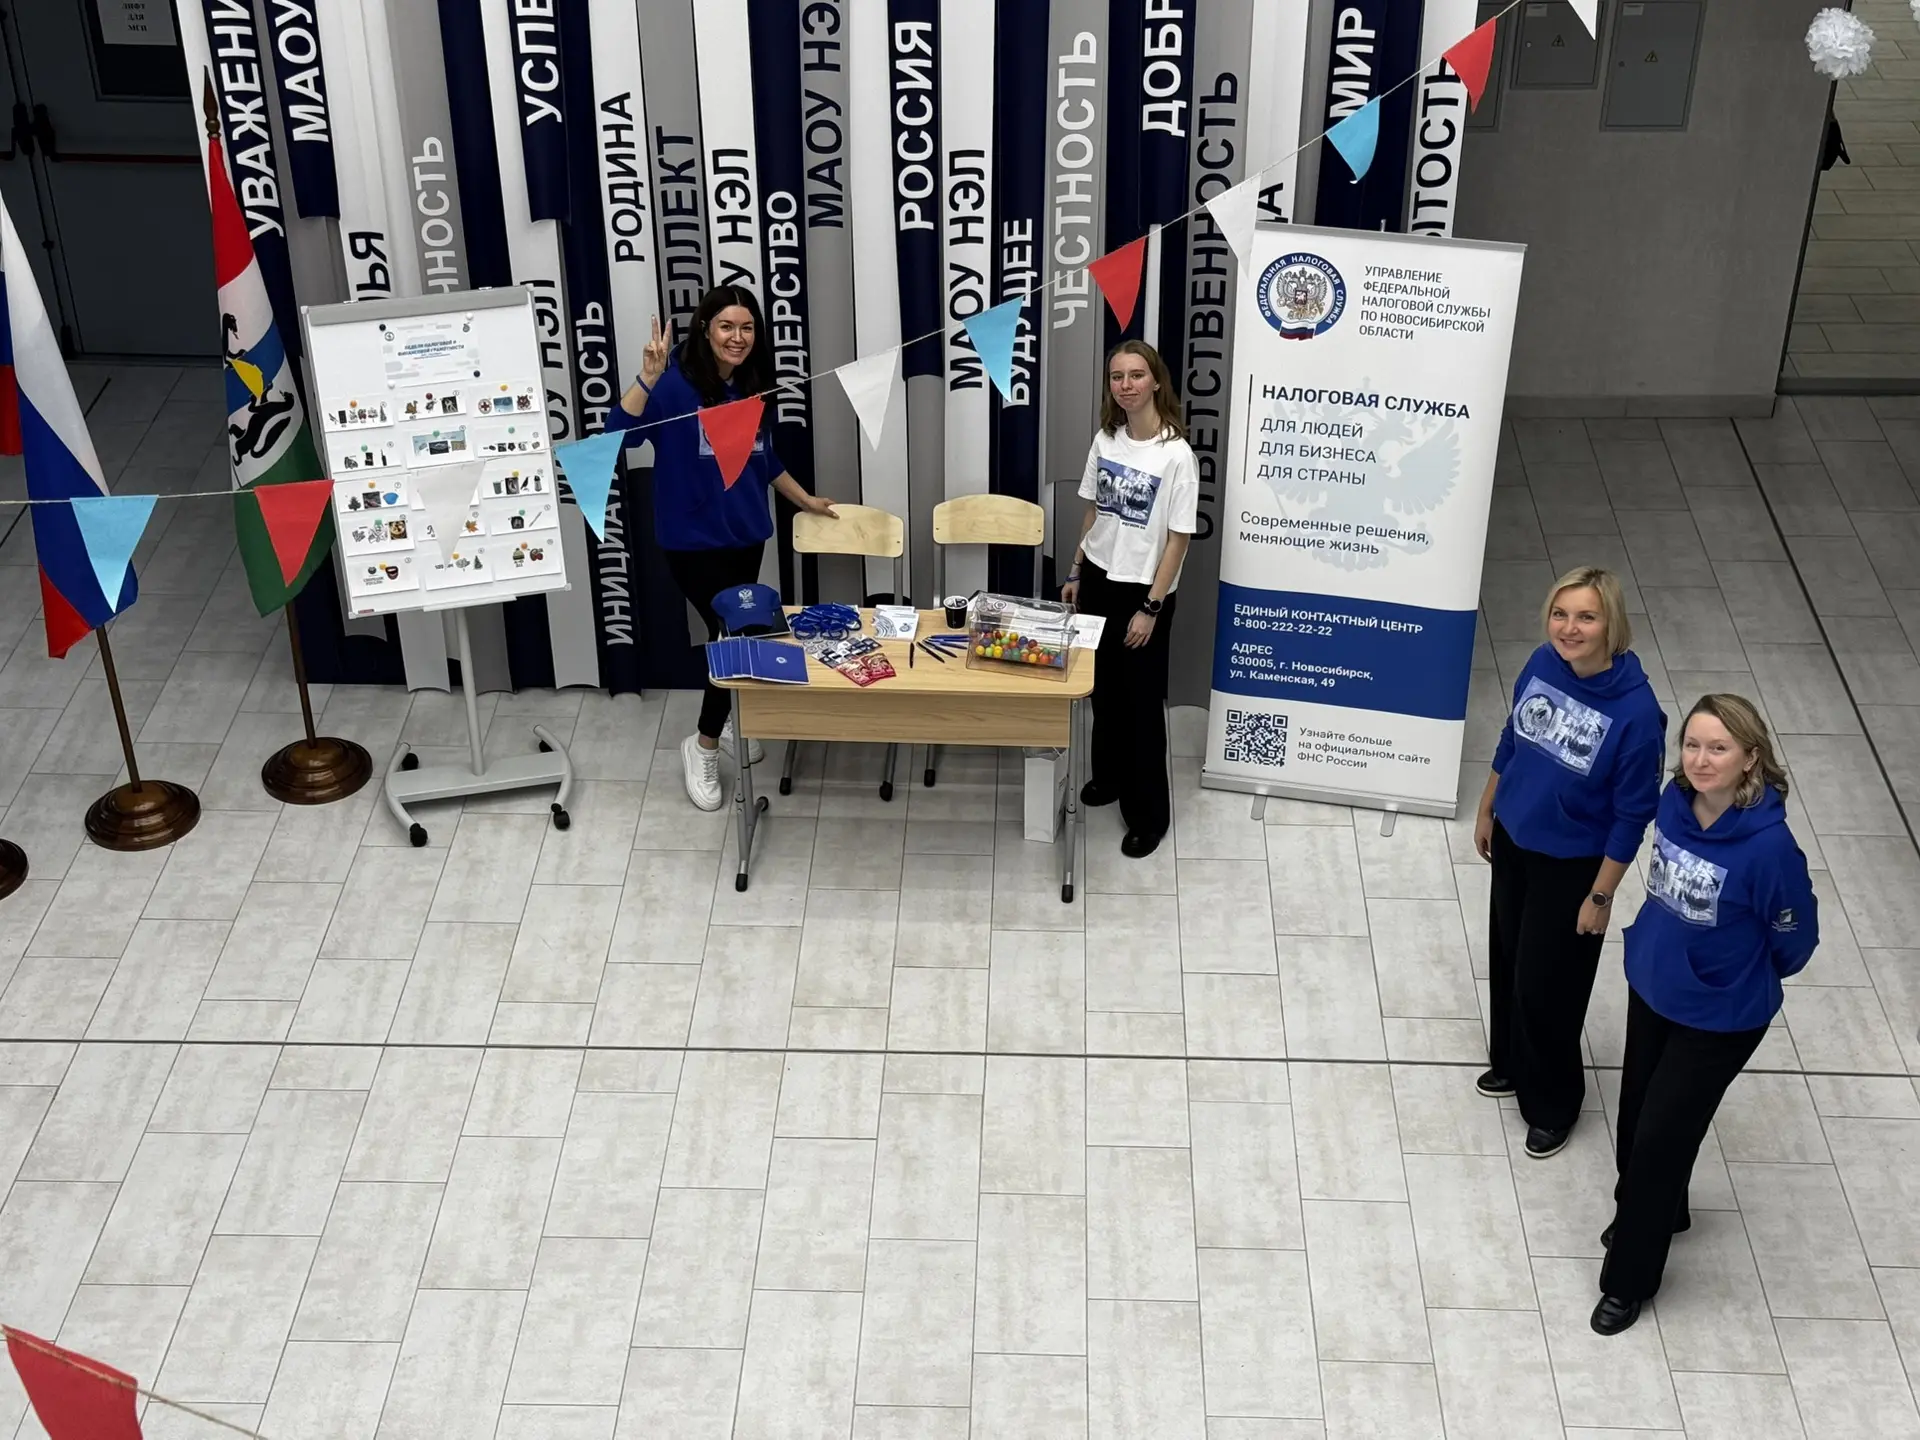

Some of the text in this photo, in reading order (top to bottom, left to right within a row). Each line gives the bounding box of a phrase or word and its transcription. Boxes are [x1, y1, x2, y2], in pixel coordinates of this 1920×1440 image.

[272, 0, 330, 142] МАОУ
[1329, 8, 1375, 118] МИР
[802, 0, 843, 228] МАОУ НЭ
[895, 22, 934, 231] РОССИЯ
[600, 91, 646, 263] РОДИНА
[1053, 31, 1097, 329] ЧЕСТНОСТЬ
[712, 149, 753, 245] НЭЛ
[949, 149, 985, 246] НЭЛ
[1365, 265, 1443, 283] УПРАВЛЕНИЕ
[1258, 255, 1344, 325] ФЕДЕРАЛЬНАЯ НАЛОГОВАЯ СЛУЖБА
[1363, 281, 1450, 299] ФЕДЕРАЛЬНОЙ
[766, 191, 807, 427] ЛИДЕРСТВО
[1361, 295, 1491, 318] НАЛОГОВОЙ СЛУЖБЫ
[1359, 324, 1414, 340] ОБЛАСТИ
[1360, 310, 1485, 332] ПО НОВОСИБИРСКОЙ
[1262, 384, 1471, 419] НАЛОГОВАЯ СЛУЖБА
[1260, 417, 1364, 439] ДЛЯ ЛЮДЕЙ
[1258, 441, 1377, 463] ДЛЯ БИЗНЕСА
[1257, 464, 1366, 486] ДЛЯ СТРАНЫ
[1240, 511, 1430, 545] Современные решения,
[1239, 531, 1379, 555] меняющие жизнь
[1233, 617, 1333, 636] 8-800-222-22-22
[1234, 603, 1424, 634] ЕДИНЫЙ КОНТАКТНЫЙ ЦЕНТР
[1232, 642, 1273, 655] АДРЕС
[1229, 669, 1336, 688] ул. Каменская, 49
[1231, 655, 1374, 681] 630005, г. Новосибирск,
[1300, 727, 1393, 747] Узнайте больше
[1297, 752, 1368, 769] ФНС России
[1298, 740, 1431, 765] на официальном сайте
